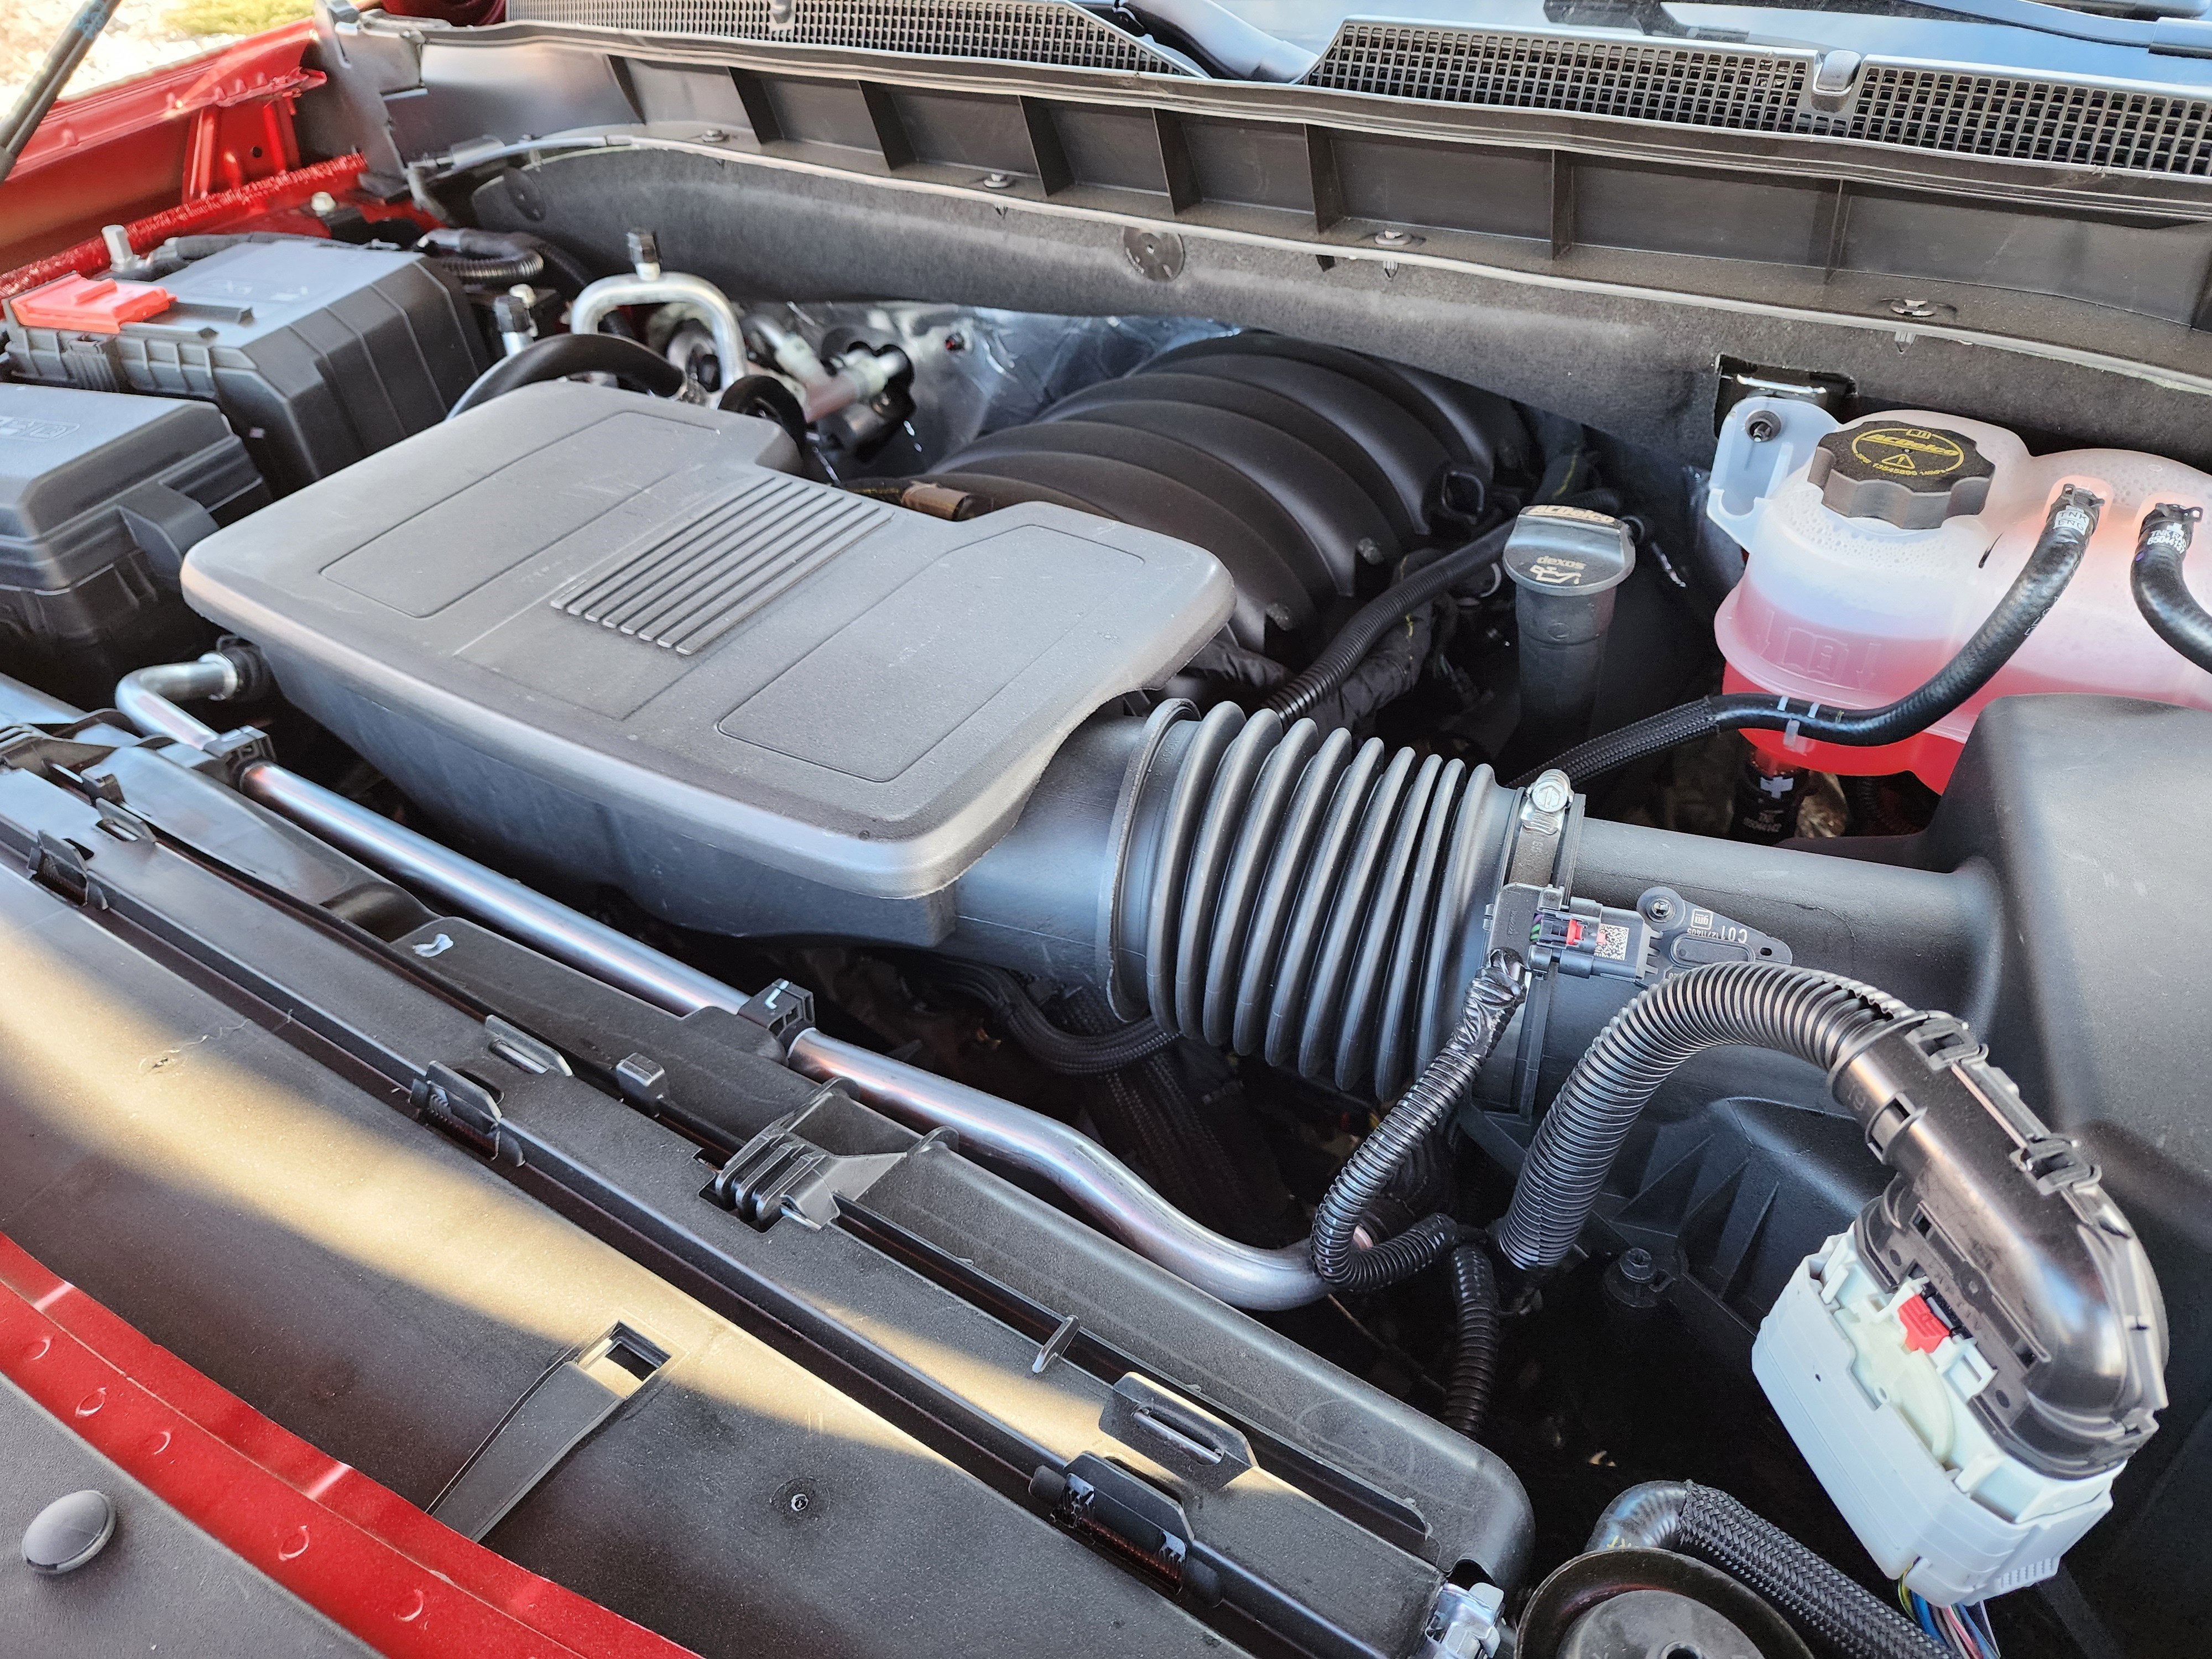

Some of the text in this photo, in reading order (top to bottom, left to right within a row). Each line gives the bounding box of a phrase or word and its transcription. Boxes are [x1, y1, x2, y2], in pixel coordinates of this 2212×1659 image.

[1861, 435, 1960, 456] ACDelco
[1526, 505, 1615, 524] ACDelco
[2059, 511, 2087, 523] TNK
[2058, 520, 2084, 531] ENG
[1537, 555, 1587, 570] dexos
